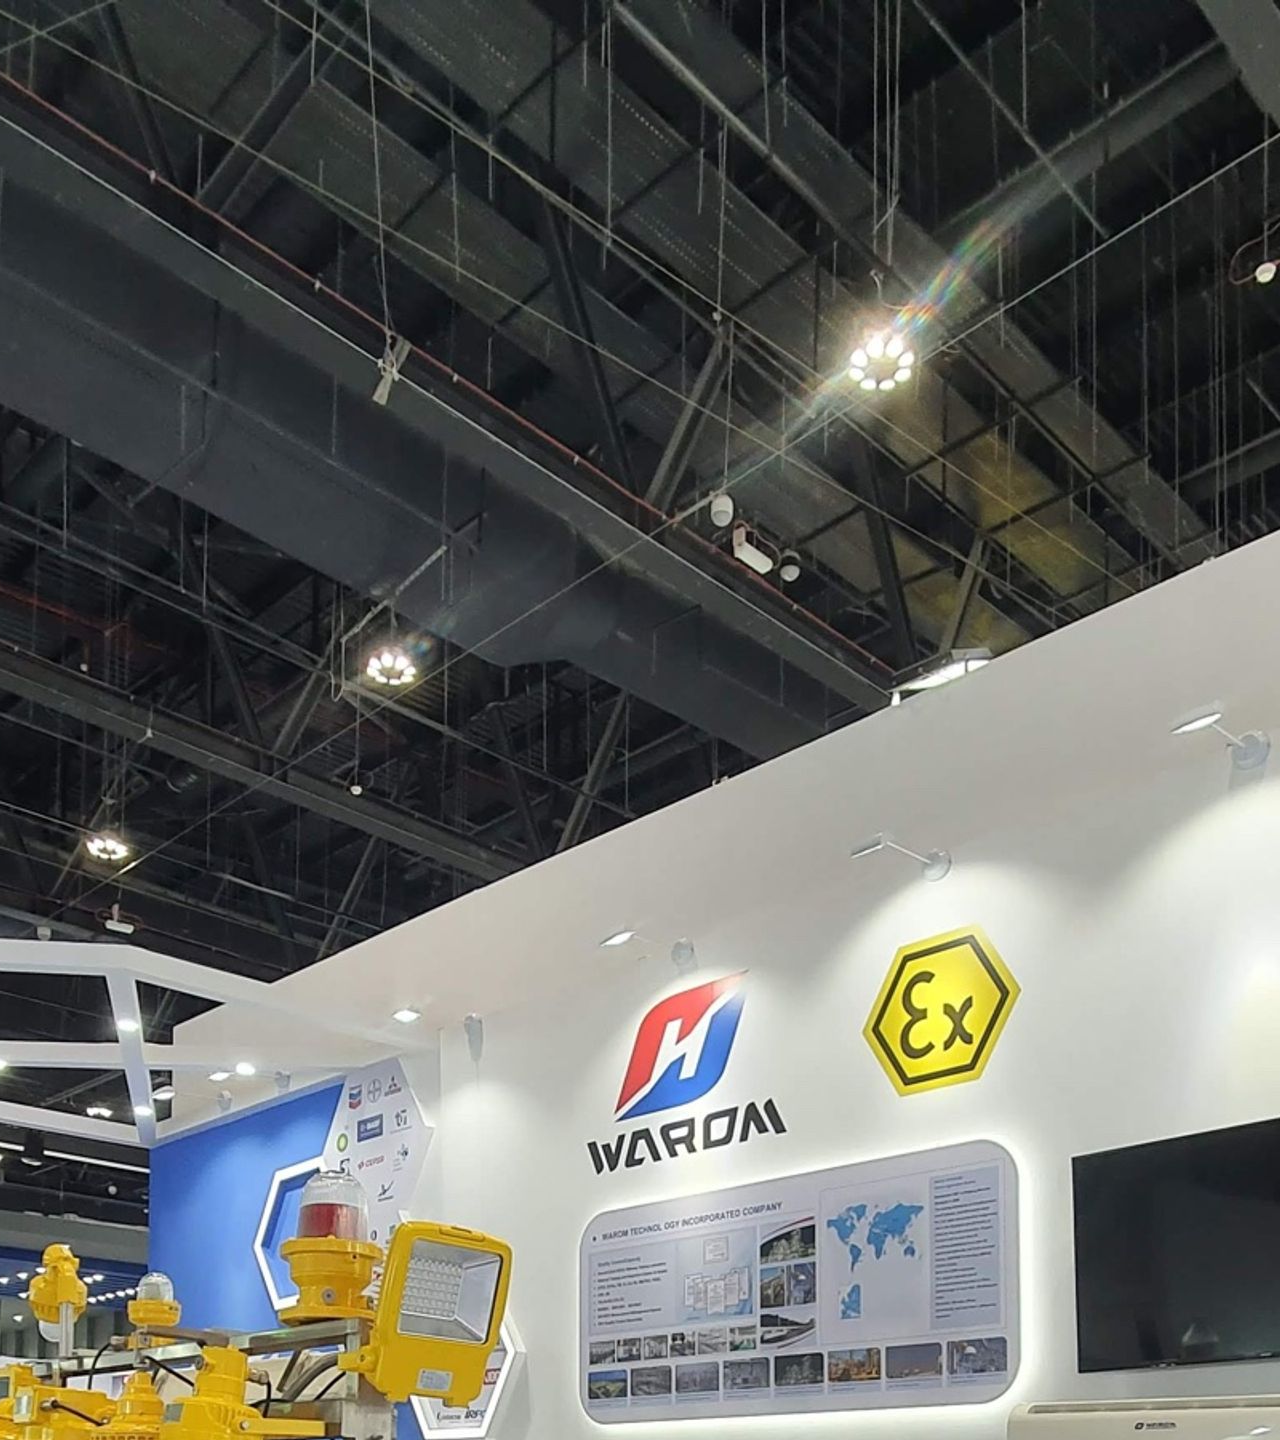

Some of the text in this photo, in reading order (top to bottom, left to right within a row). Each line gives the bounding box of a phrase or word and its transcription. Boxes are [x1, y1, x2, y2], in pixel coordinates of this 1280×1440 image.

[586, 1097, 788, 1176] WAROM
[601, 1229, 629, 1241] WAROM
[681, 1208, 741, 1227] INCORPORATED
[742, 1201, 783, 1216] COMPANY
